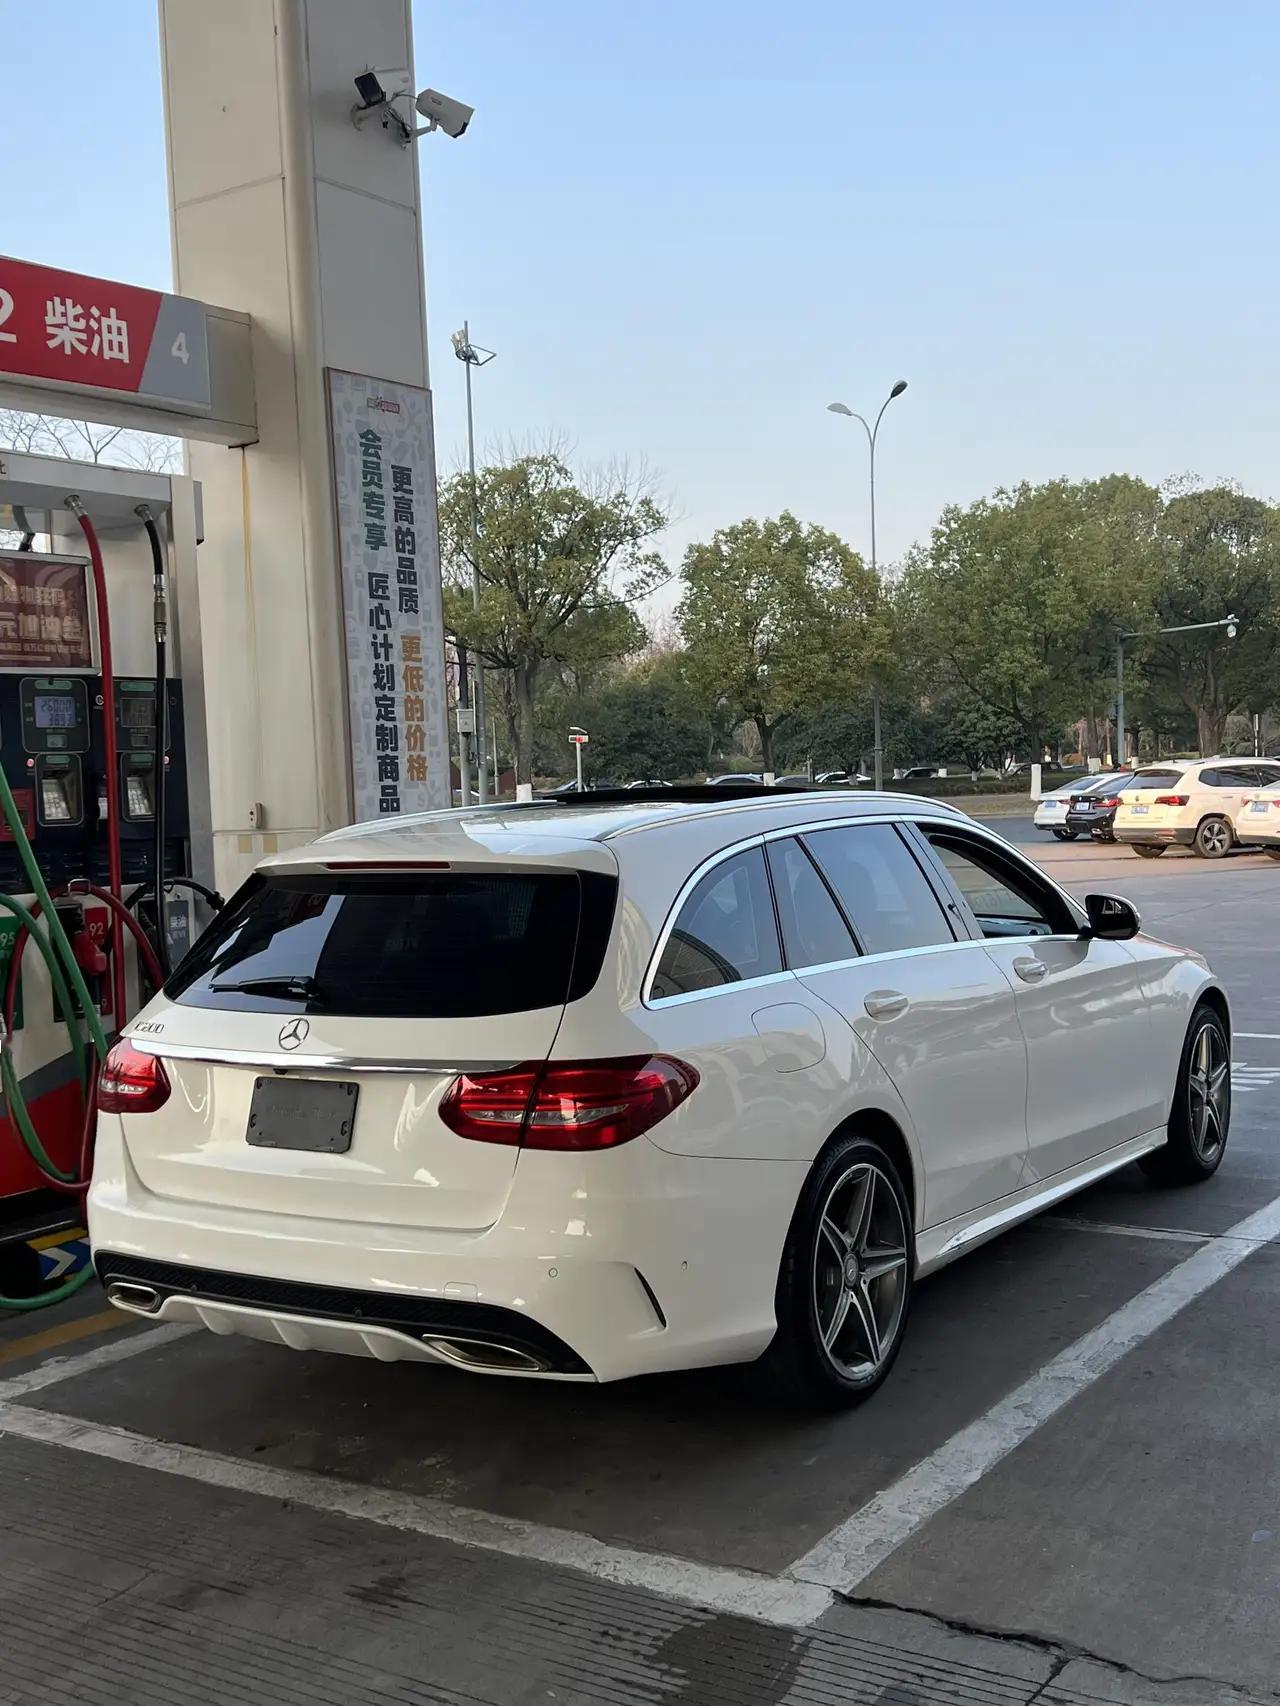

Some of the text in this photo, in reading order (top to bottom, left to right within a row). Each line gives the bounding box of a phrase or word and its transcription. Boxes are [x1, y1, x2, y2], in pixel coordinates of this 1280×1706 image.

[44, 296, 130, 364] 柴油
[171, 332, 190, 365] 4
[358, 428, 388, 551] 会员专享
[390, 464, 428, 781] 更高的品质 更低的价格
[367, 571, 400, 813] 匠心计划定制商品
[0, 932, 16, 948] 95
[89, 922, 105, 937] 92
[134, 1021, 165, 1034] C200
